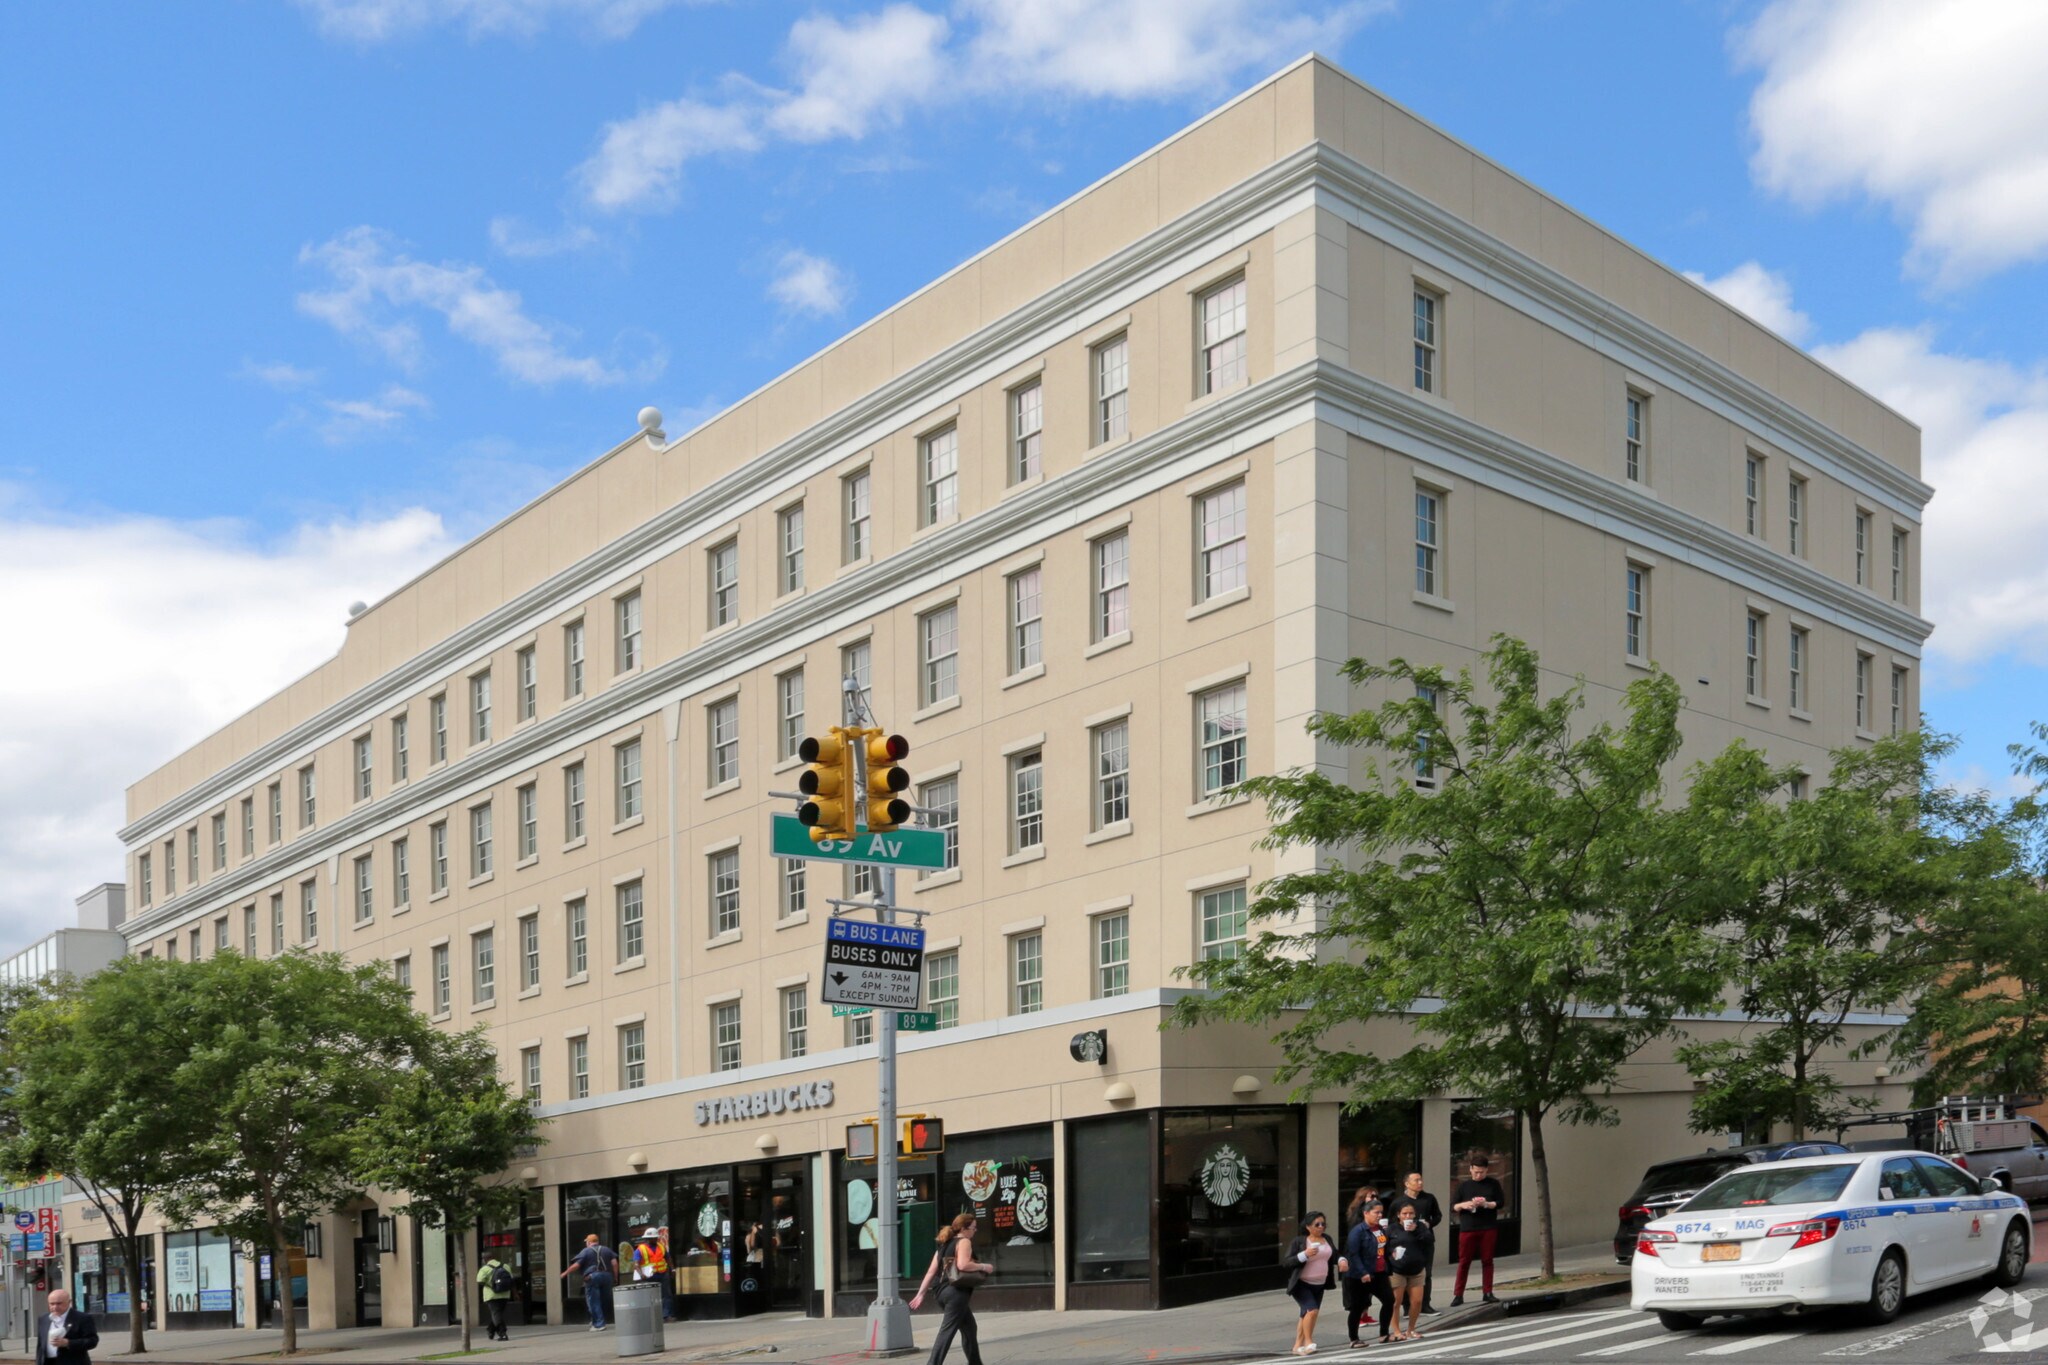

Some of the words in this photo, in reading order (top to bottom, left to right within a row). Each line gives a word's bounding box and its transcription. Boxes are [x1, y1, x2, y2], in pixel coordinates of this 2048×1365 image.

[867, 833, 903, 858] Av
[850, 925, 878, 941] BUS
[882, 929, 919, 946] LANE
[831, 944, 877, 963] BUSES
[881, 950, 917, 967] ONLY
[861, 970, 882, 980] 6AM
[891, 973, 911, 983] 9AM
[860, 981, 882, 991] 4PM
[891, 984, 910, 993] 7PM
[840, 990, 875, 1000] EXCEPT
[878, 994, 916, 1004] SUNDAY
[903, 1014, 916, 1029] 89
[694, 1079, 834, 1126] STARBUCKS
[1675, 1222, 1711, 1234] 8674
[1735, 1219, 1765, 1230] MAG
[1843, 1219, 1867, 1231] 8674
[1654, 1277, 1689, 1285] DRIVERS
[1654, 1285, 1689, 1294] WANTED
